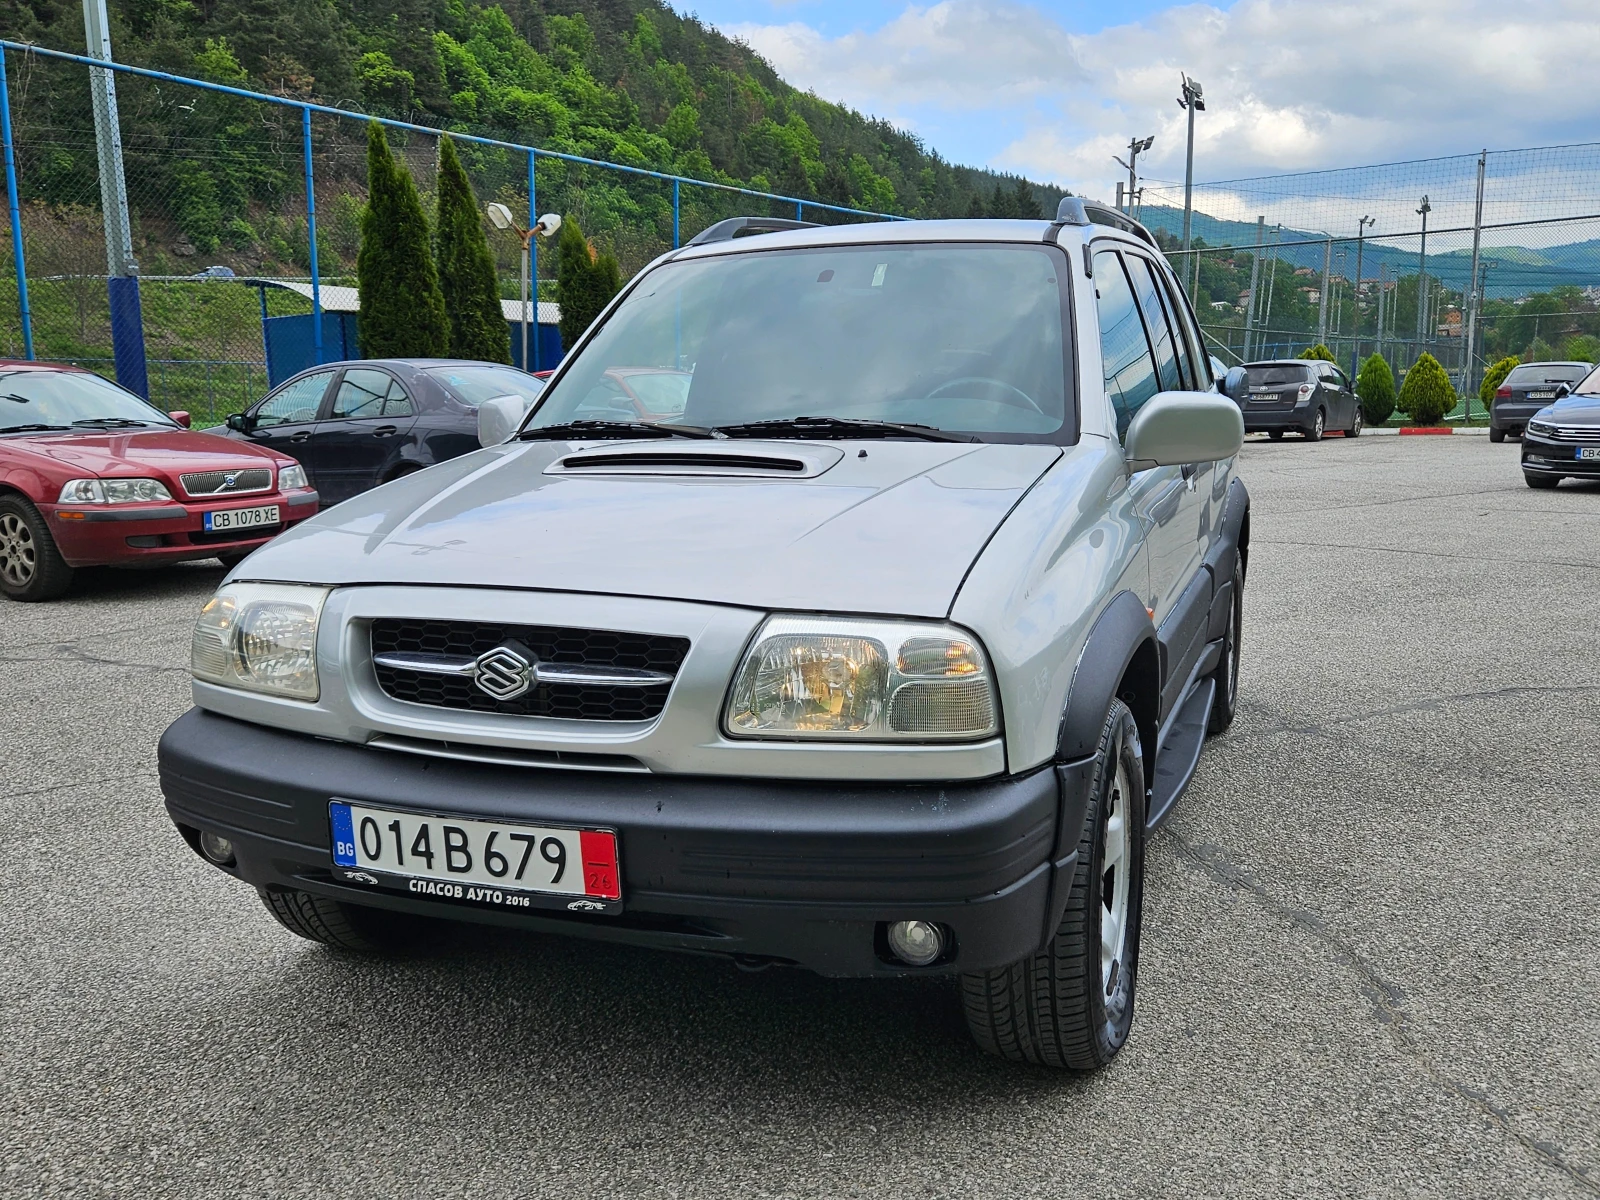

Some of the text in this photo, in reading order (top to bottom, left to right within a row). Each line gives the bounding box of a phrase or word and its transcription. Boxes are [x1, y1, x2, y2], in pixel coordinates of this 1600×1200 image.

[1582, 449, 1594, 458] CB
[213, 507, 278, 527] CB 1078 XE
[337, 842, 353, 856] BG
[590, 874, 612, 889] 26
[409, 879, 530, 907] СПАСОВ АУТО 2016
